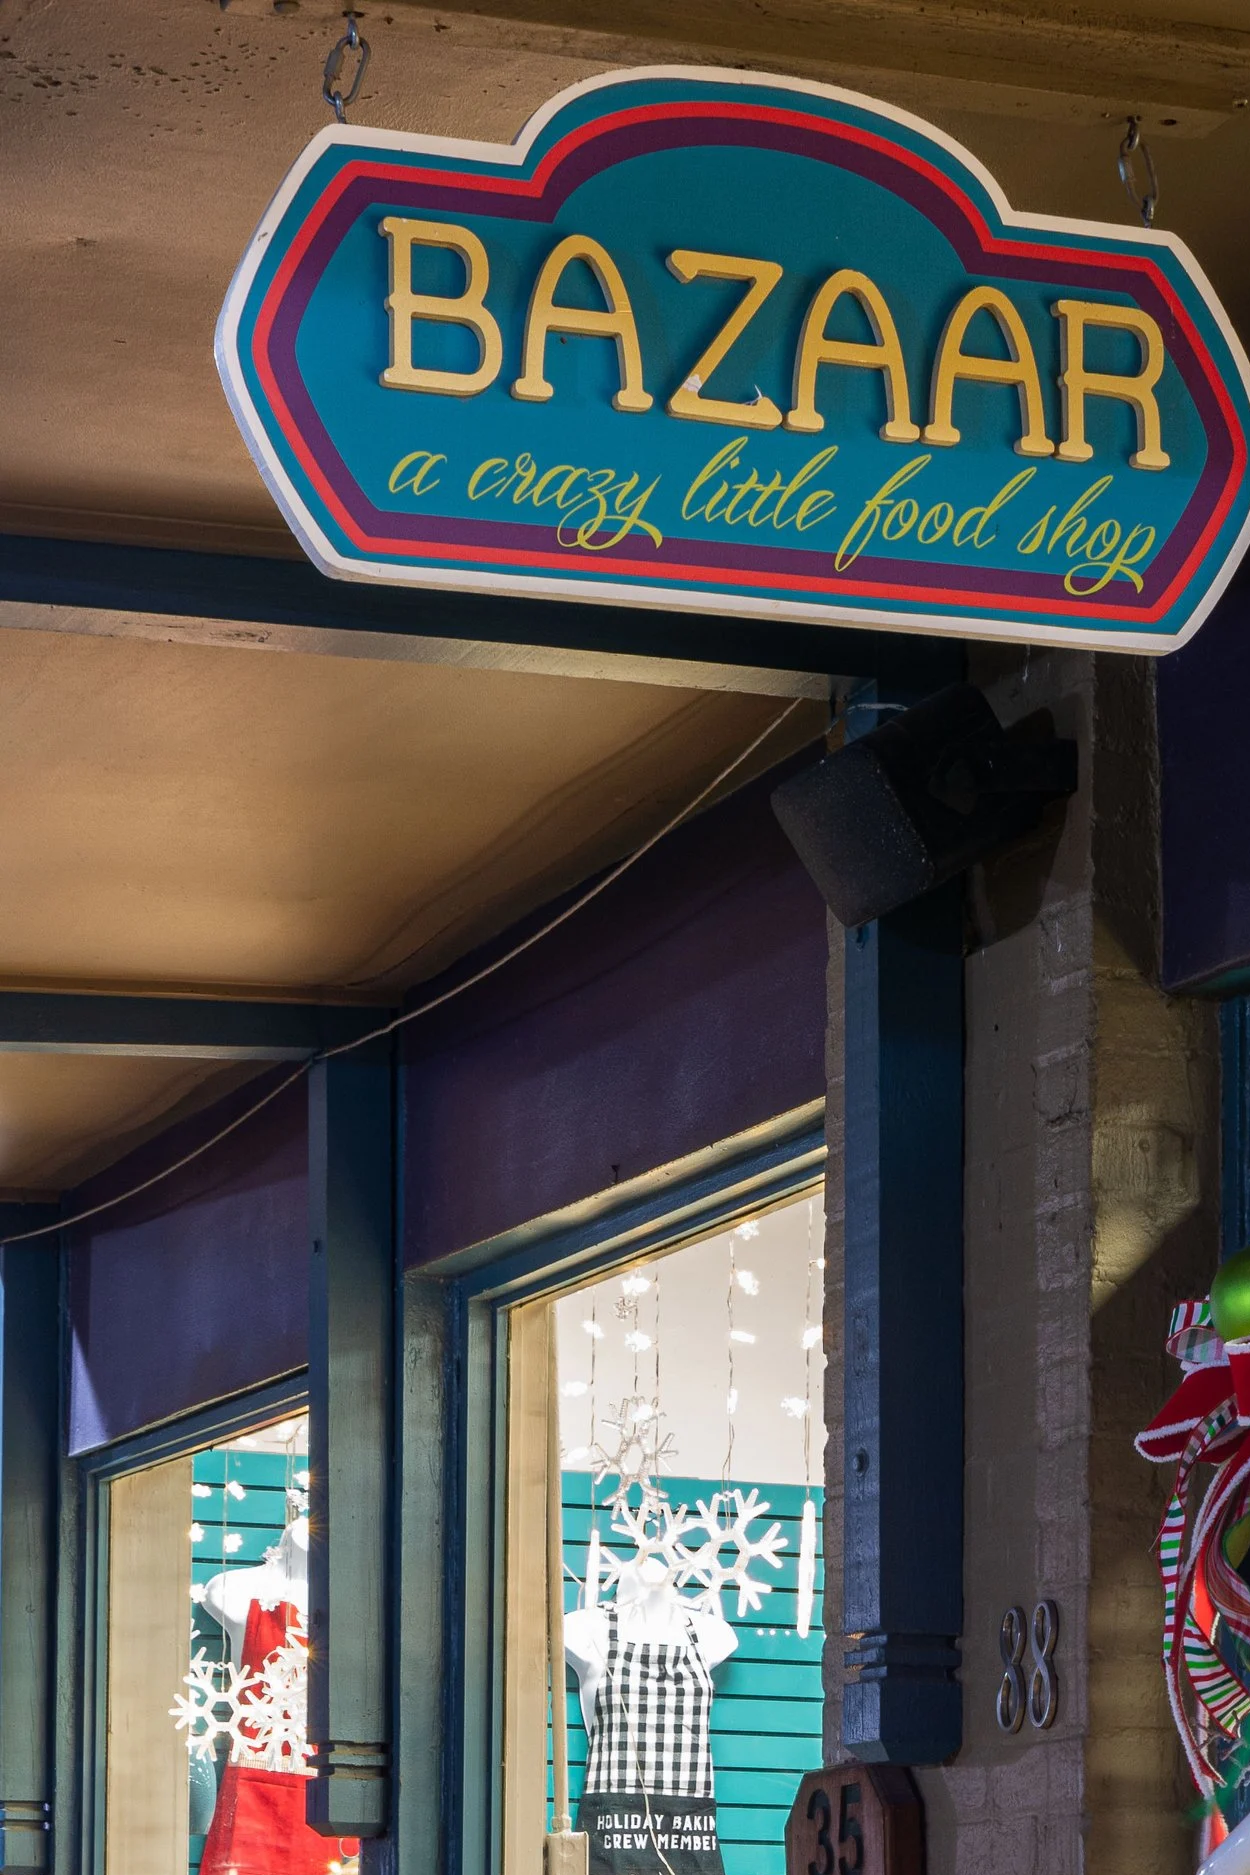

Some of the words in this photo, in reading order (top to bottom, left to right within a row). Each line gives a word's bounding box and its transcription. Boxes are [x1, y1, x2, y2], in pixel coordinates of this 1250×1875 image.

[378, 216, 1171, 471] BAZAAR
[388, 451, 447, 495] a
[468, 453, 663, 550] crazy
[681, 436, 838, 531] little
[834, 454, 1037, 572] food
[1017, 475, 1155, 596] shop
[996, 1600, 1058, 1735] 88
[597, 1814, 665, 1831] HOLIDAY
[603, 1833, 649, 1850] CREW
